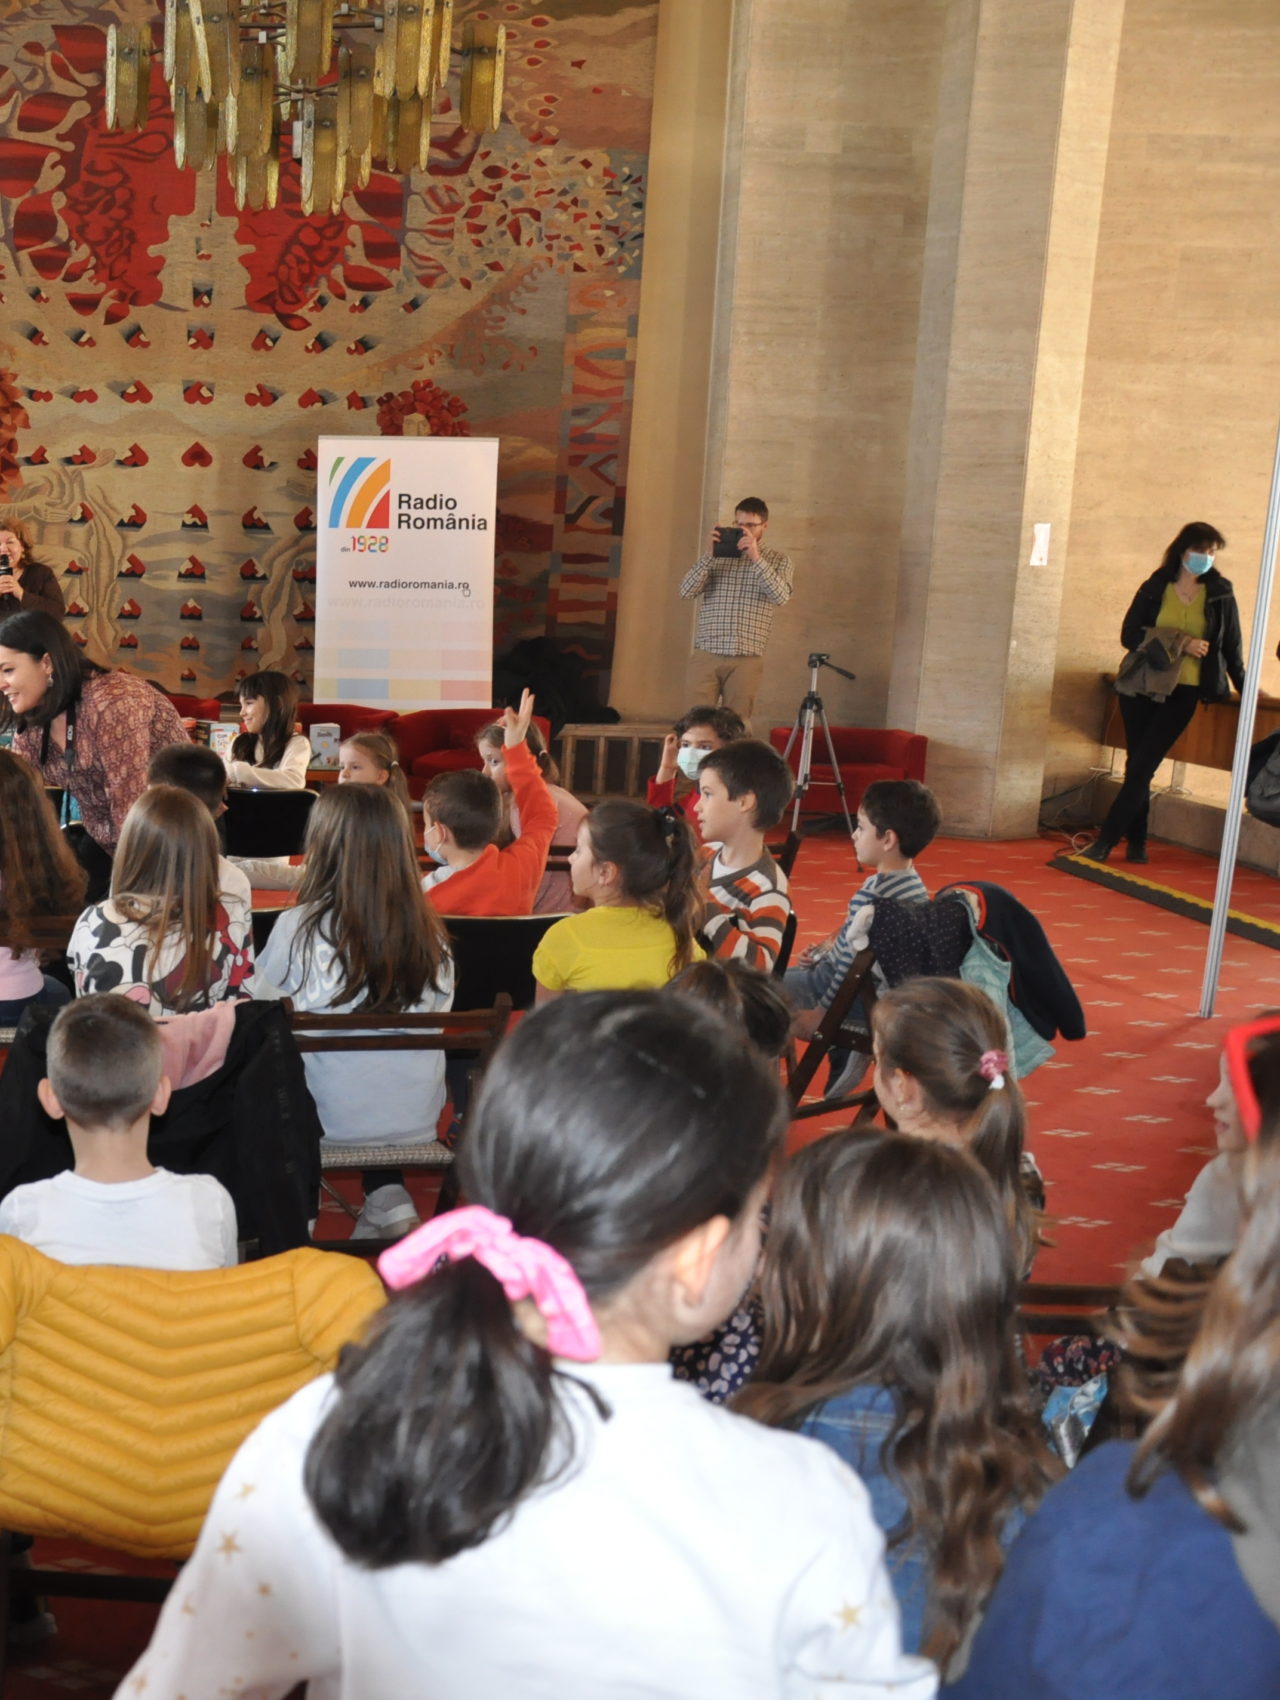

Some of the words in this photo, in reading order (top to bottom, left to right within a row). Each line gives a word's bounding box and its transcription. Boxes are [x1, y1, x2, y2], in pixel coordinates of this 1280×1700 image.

[398, 493, 457, 510] Radio
[398, 513, 488, 530] România
[351, 535, 389, 552] 1928
[348, 579, 469, 590] www.radioromania.ro
